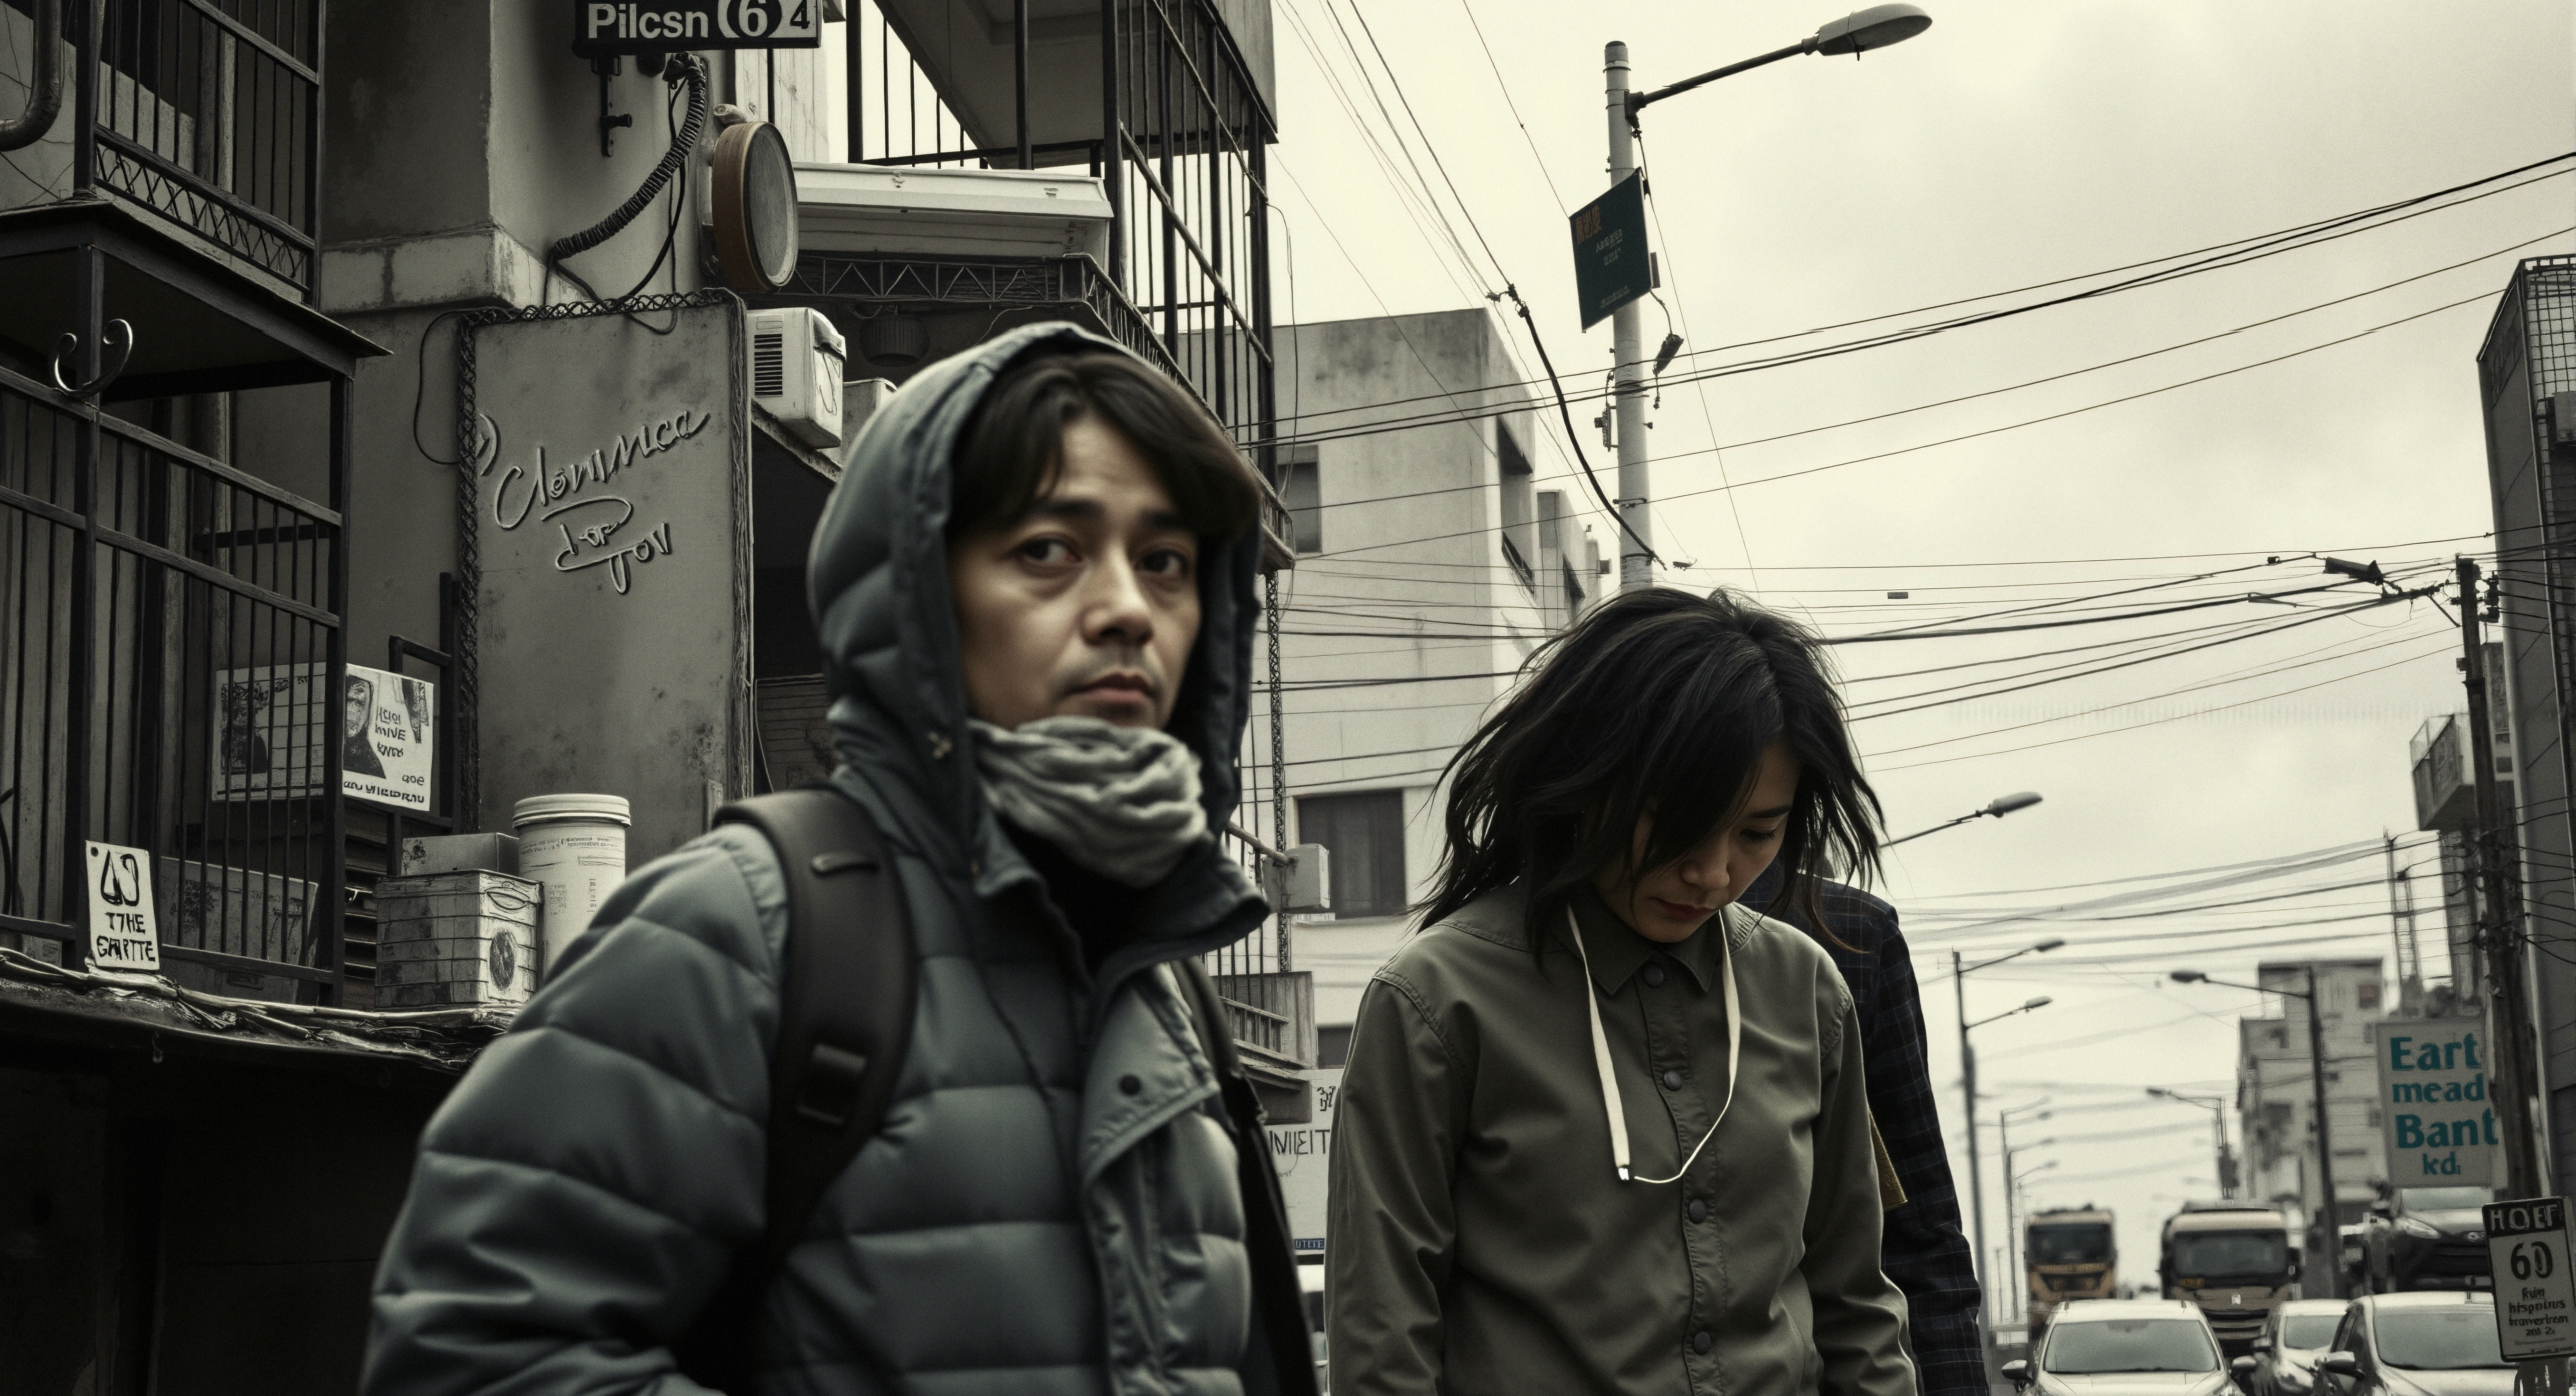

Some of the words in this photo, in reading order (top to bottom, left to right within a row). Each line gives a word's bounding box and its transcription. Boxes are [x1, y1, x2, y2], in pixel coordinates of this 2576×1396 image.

[588, 3, 709, 39] Pilcsn
[2390, 1033, 2482, 1071] Eart
[2392, 1073, 2485, 1103] mead
[2395, 1107, 2498, 1149] Bant
